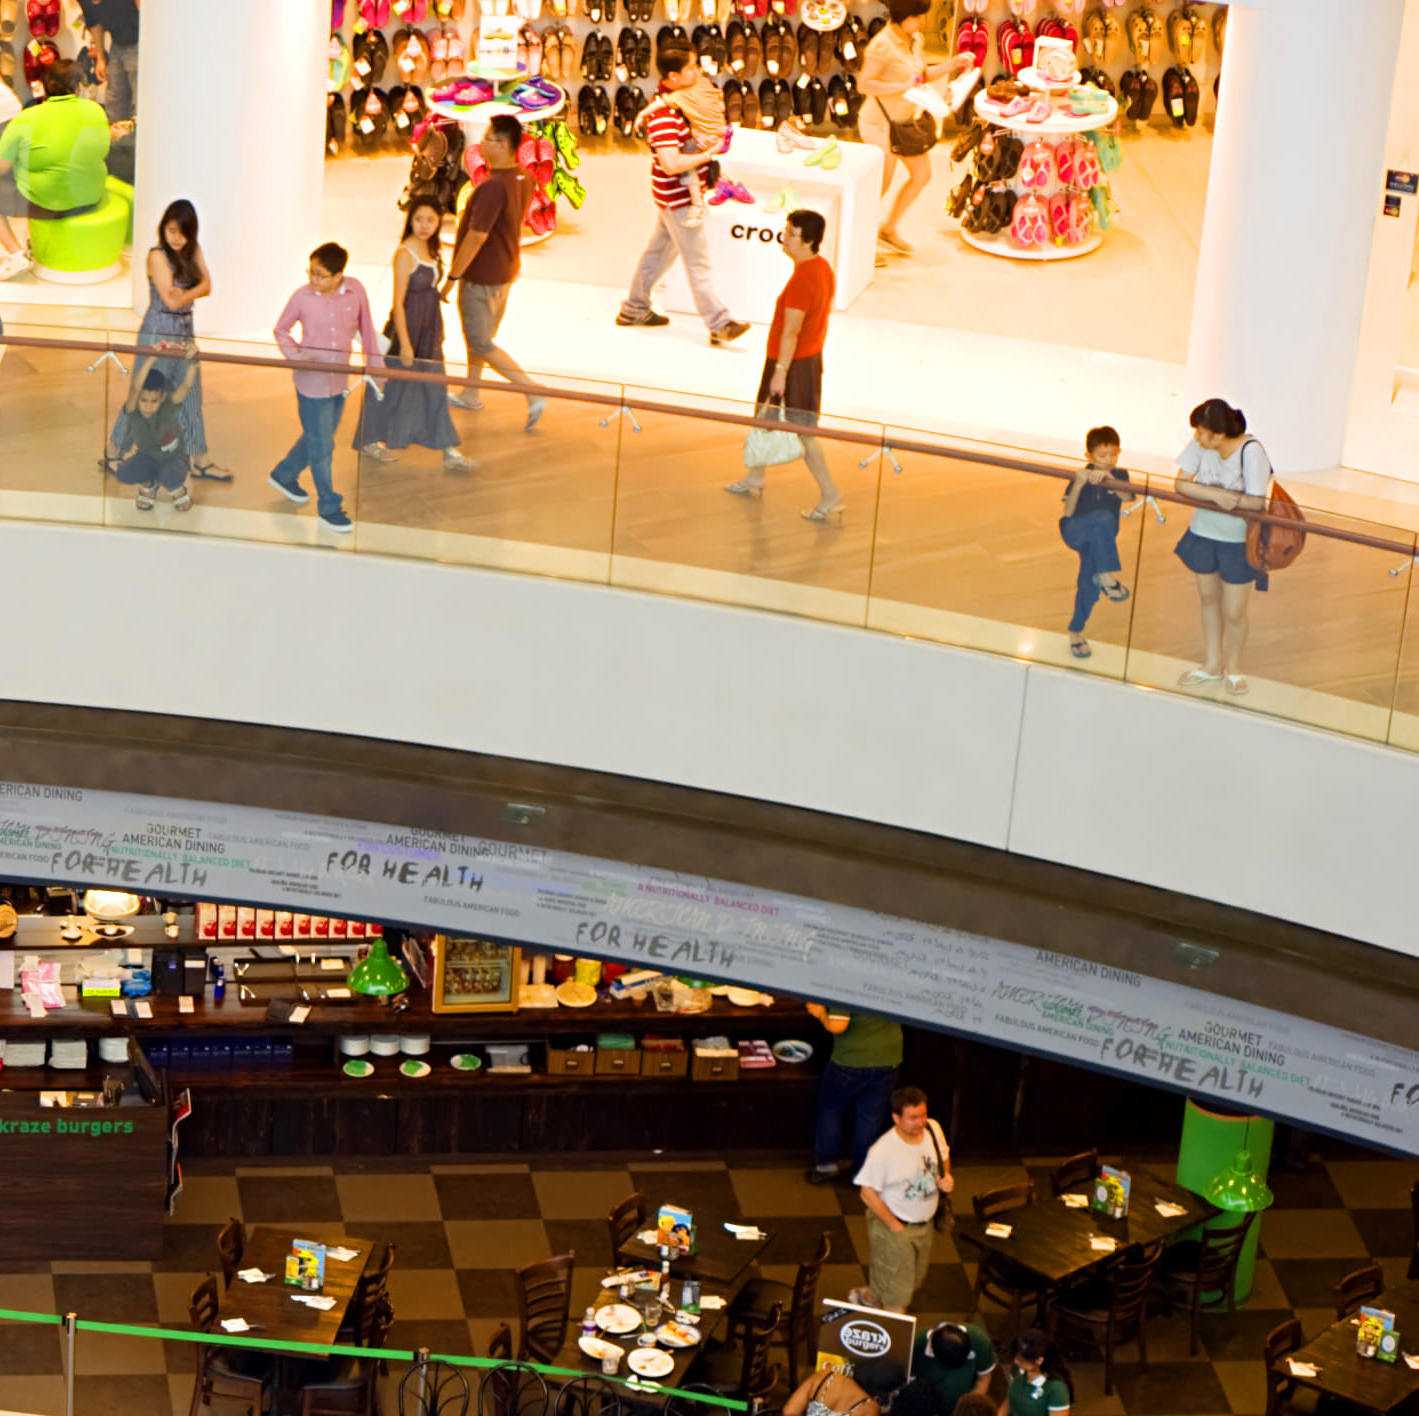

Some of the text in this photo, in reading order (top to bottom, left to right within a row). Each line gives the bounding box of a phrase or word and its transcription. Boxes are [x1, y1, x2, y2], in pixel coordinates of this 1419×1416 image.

[44, 786, 83, 801] DINING
[122, 833, 225, 854] AMERICAN DINING
[147, 823, 202, 839] GOURMET
[387, 833, 447, 853] AMERICAN
[29, 854, 48, 863] FOOD
[51, 850, 207, 887] FOR HEALTH
[326, 850, 370, 875] FOR
[383, 859, 484, 893] HEALTH
[645, 884, 710, 903] NUTRITIONALLY
[715, 896, 760, 913] BALANCED
[576, 921, 621, 947] FOR
[633, 931, 735, 968] HEALTH
[1036, 950, 1142, 989] AMERICAN DINING
[995, 1013, 1099, 1048] FABULOUS AMERICAN FOOD
[1205, 1021, 1263, 1046] GOURMET
[1178, 1029, 1286, 1067] AMERICAN DINING
[1100, 1037, 1264, 1099] FOR HEALTH
[57, 1118, 134, 1136] burgers
